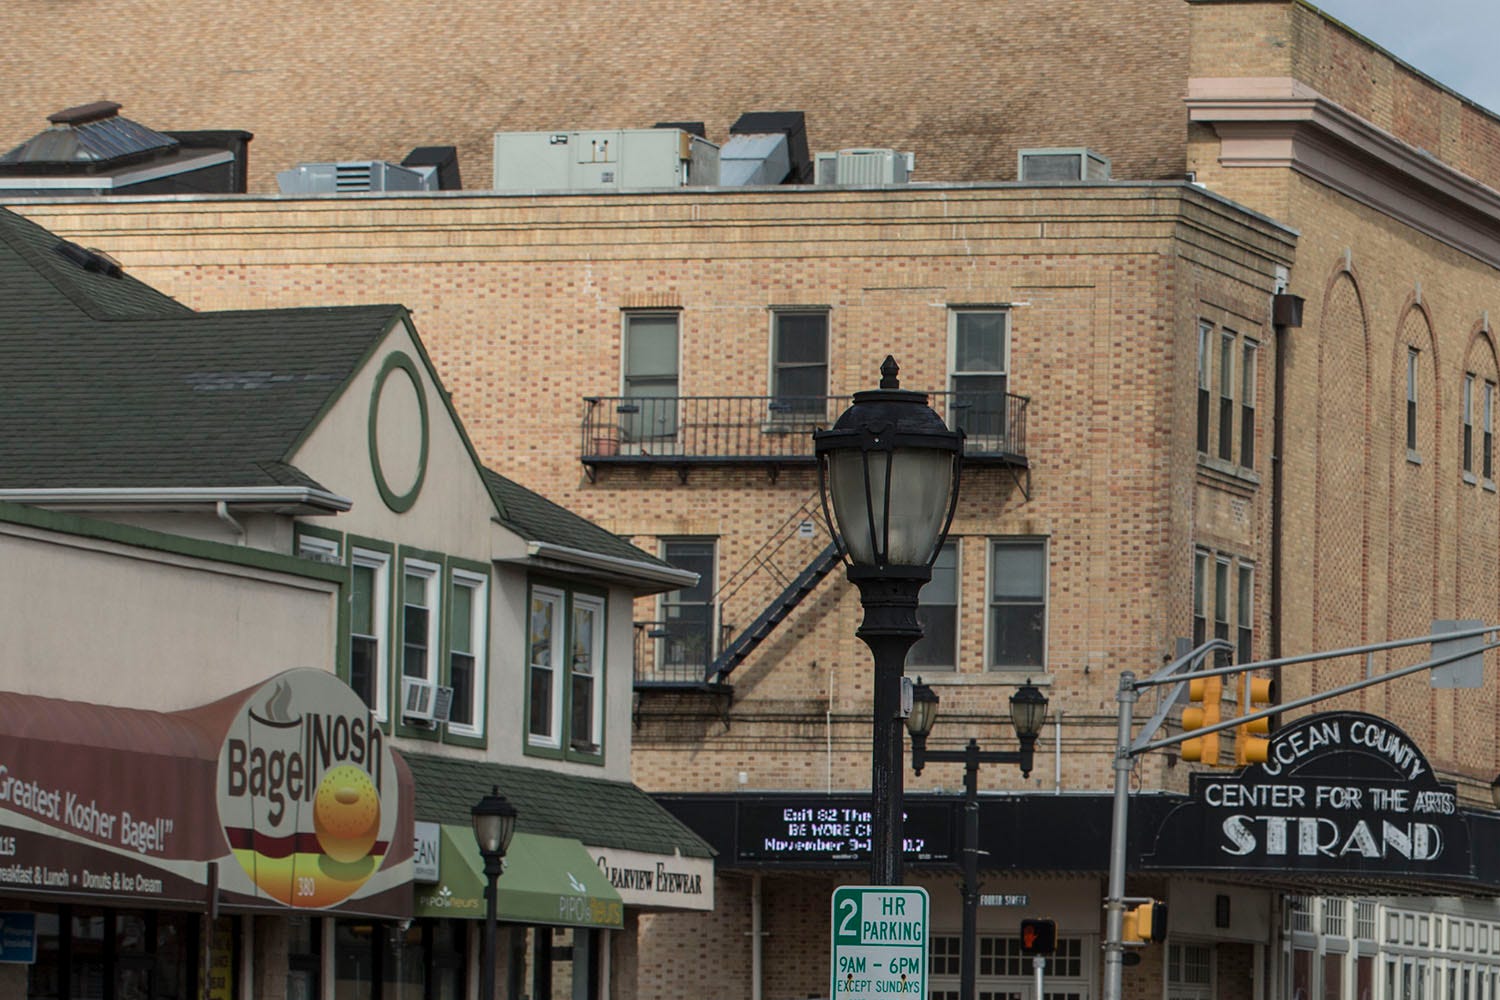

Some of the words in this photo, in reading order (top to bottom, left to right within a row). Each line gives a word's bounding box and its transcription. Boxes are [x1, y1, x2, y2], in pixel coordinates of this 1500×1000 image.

[1262, 721, 1341, 776] OCEAN
[1350, 720, 1426, 781] COUNTY
[228, 713, 311, 827] Bagel
[312, 712, 382, 800] Nosh
[0, 765, 61, 821] Greatest
[64, 791, 117, 839] Kosher
[1205, 784, 1305, 808] CENTER
[1316, 786, 1362, 810] FOR
[1369, 787, 1409, 812] THE
[1413, 791, 1456, 815] ARTS
[788, 824, 807, 836] BE
[1220, 815, 1444, 860] STRAND
[764, 838, 845, 852] November
[35, 866, 41, 883] &
[43, 868, 69, 887] Lunch
[83, 870, 111, 889] Donuts
[113, 872, 120, 890] &
[122, 873, 134, 890] Ice
[135, 875, 162, 893] Cream
[298, 878, 315, 896] 380
[656, 862, 702, 895] EYEWEAR
[839, 898, 858, 936] 2
[882, 897, 906, 916] HR
[863, 921, 921, 941] PARKING
[839, 956, 866, 973] 9AM
[889, 957, 919, 974] 6PM
[837, 980, 872, 993] EXCEPT
[876, 980, 920, 993] SUNDAYS
